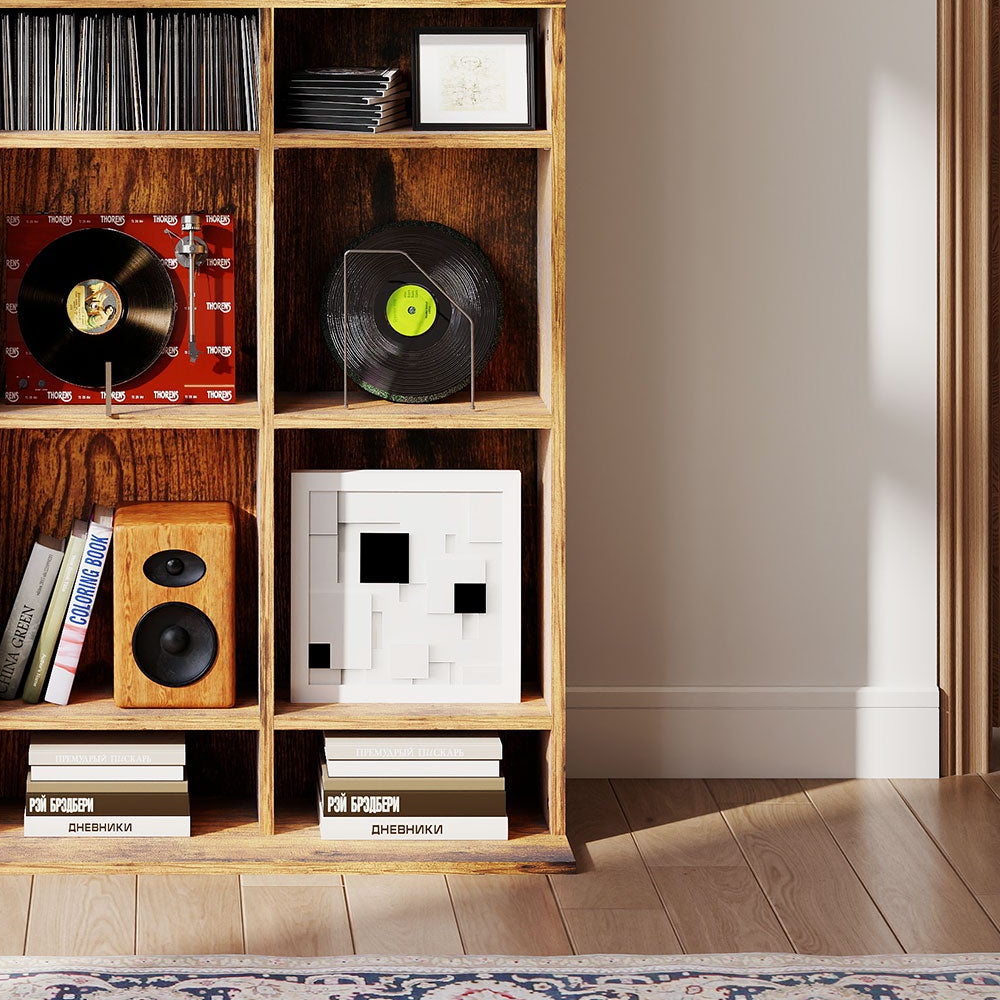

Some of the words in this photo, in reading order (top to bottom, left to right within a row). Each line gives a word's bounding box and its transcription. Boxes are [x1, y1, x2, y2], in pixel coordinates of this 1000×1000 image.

[48, 215, 73, 226] THORENS
[100, 215, 126, 226] THORENS
[153, 215, 178, 226] THORENS
[205, 214, 231, 226] THORENS
[206, 258, 231, 269] THORENS
[206, 301, 232, 313] THORENS
[206, 346, 232, 357] THORENS
[47, 391, 73, 402] THORENS
[100, 391, 126, 402] THRENS
[153, 391, 179, 402] THORENS
[207, 391, 232, 402] THORENS
[69, 567, 99, 625] COLORING
[86, 534, 109, 566] BOOK
[12, 605, 36, 648] GREEN
[29, 795, 47, 813] РЭЙ
[50, 797, 94, 814] БРЭДБЕРИ
[327, 793, 347, 813] РЭЙ
[350, 796, 400, 814] БРЭДБЕРИ
[68, 823, 133, 833] ДНЕВНИКИ
[371, 824, 443, 835] ДНЕВНИКИ
